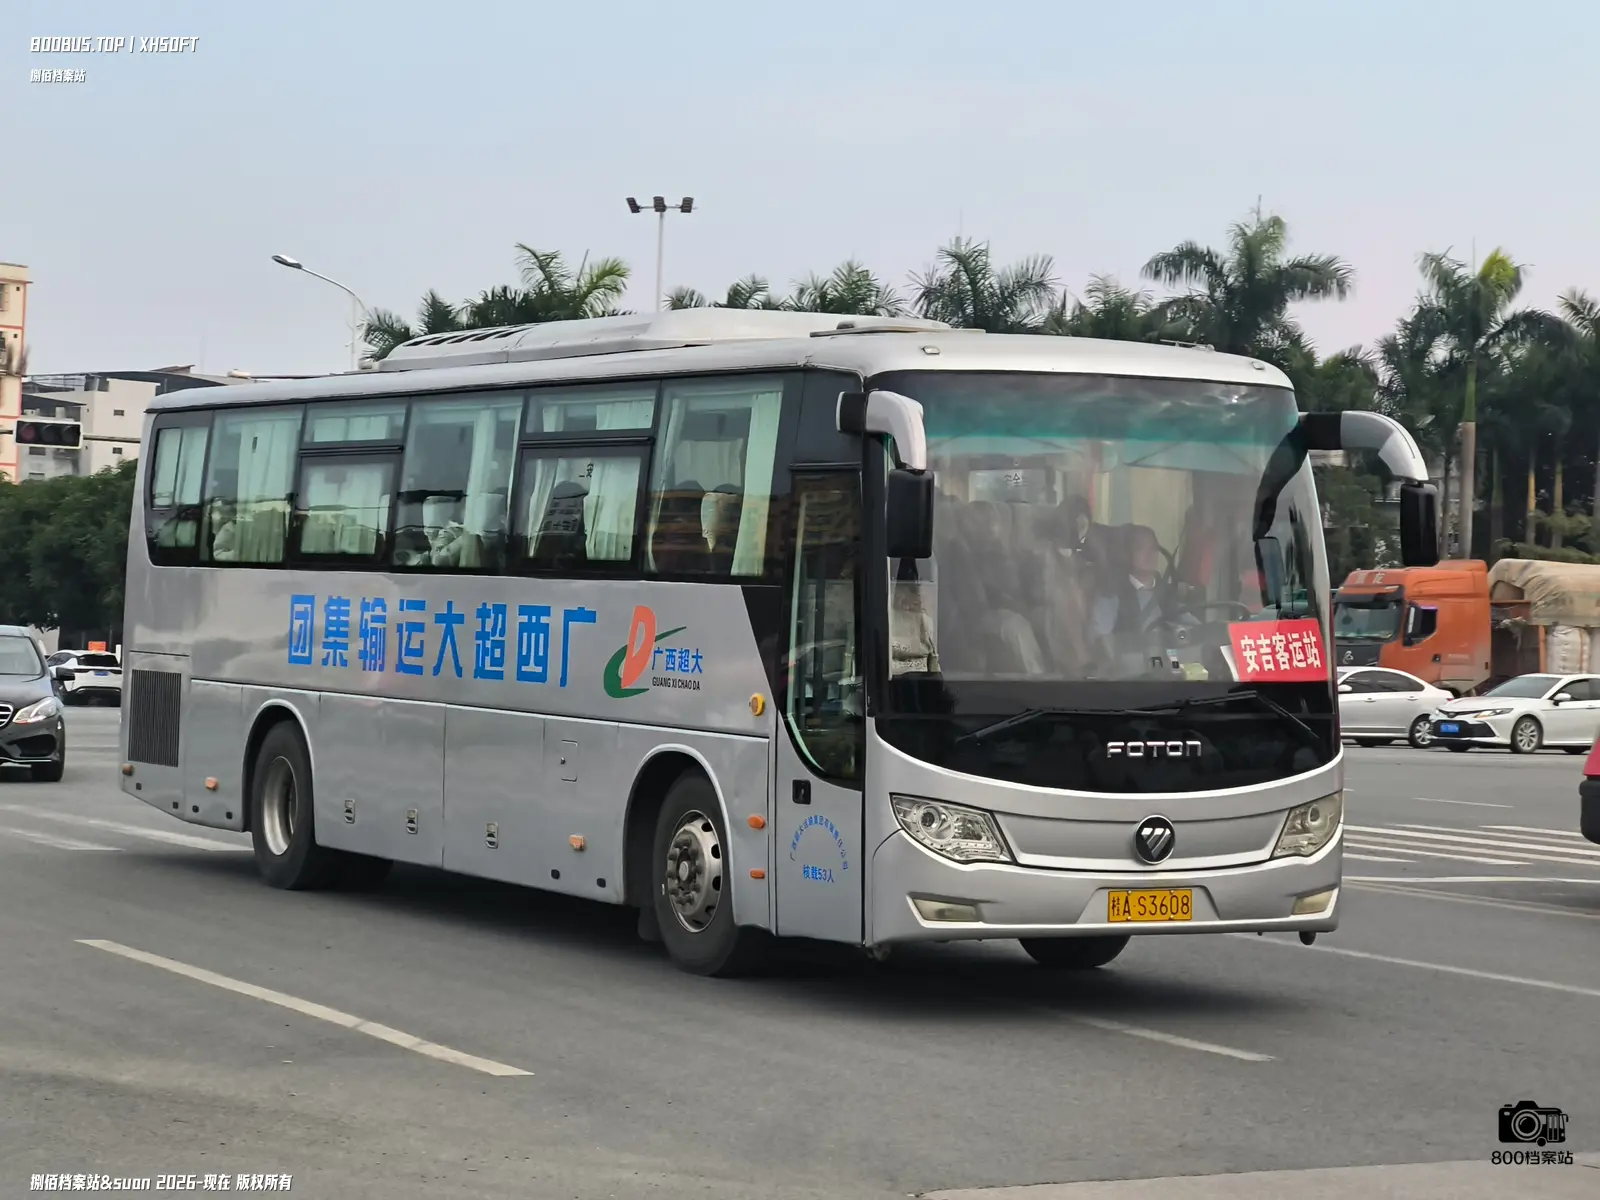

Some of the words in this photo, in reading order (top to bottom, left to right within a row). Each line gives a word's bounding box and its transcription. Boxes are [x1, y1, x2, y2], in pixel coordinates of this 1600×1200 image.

[651, 646, 703, 674] 广西超大
[1240, 631, 1321, 674] 安吉客运站
[652, 676, 671, 688] GUANG
[677, 678, 692, 690] CHAO
[692, 680, 701, 691] DA
[1107, 741, 1202, 758] FOTON
